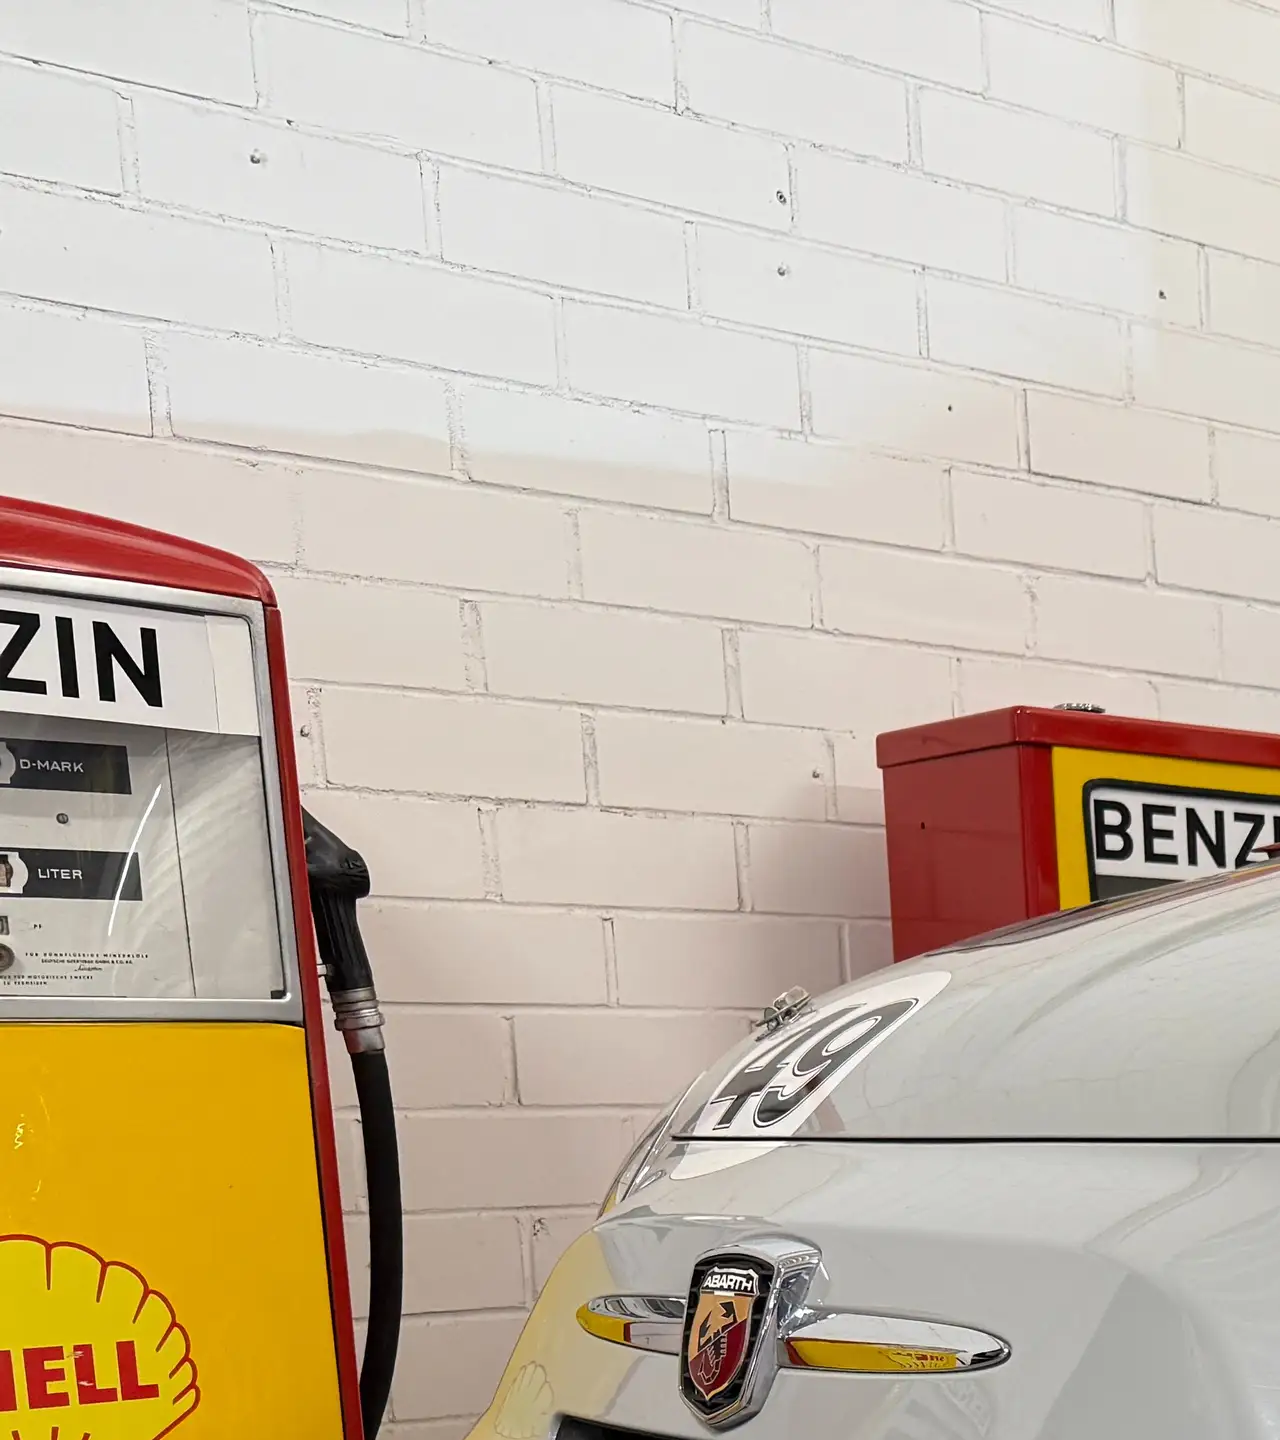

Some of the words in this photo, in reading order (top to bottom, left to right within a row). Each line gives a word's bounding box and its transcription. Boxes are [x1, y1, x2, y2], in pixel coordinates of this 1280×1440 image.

[0, 609, 163, 708] ZIN
[20, 759, 84, 773] D-MARK
[38, 868, 83, 880] LITER
[709, 998, 920, 1128] 49
[703, 1274, 753, 1291] ABARTH
